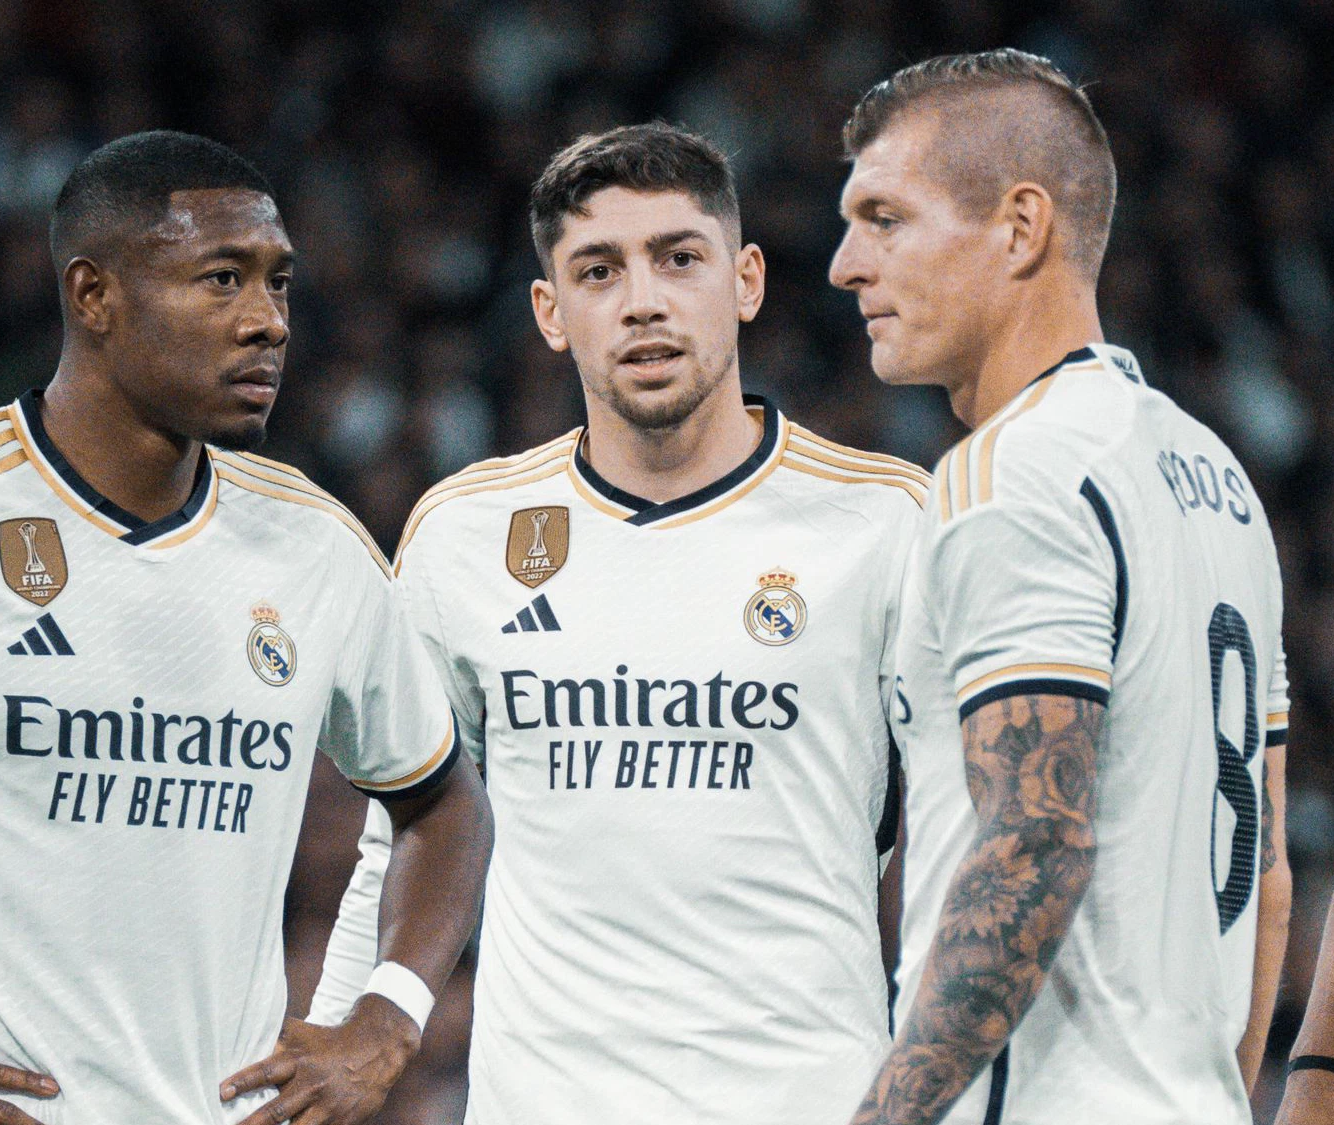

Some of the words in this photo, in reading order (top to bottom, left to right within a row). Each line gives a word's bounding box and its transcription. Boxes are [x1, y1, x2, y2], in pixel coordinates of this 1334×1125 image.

[22, 573, 53, 586] FIFA
[522, 557, 551, 569] FIFA
[526, 572, 544, 580] 2022
[500, 664, 799, 731] Emirates
[3, 695, 293, 771] Emirates
[548, 740, 603, 790] FLY
[614, 740, 754, 790] BETTER
[1208, 602, 1260, 936] 8
[48, 771, 117, 823] FLY
[127, 776, 253, 833] BETTER
